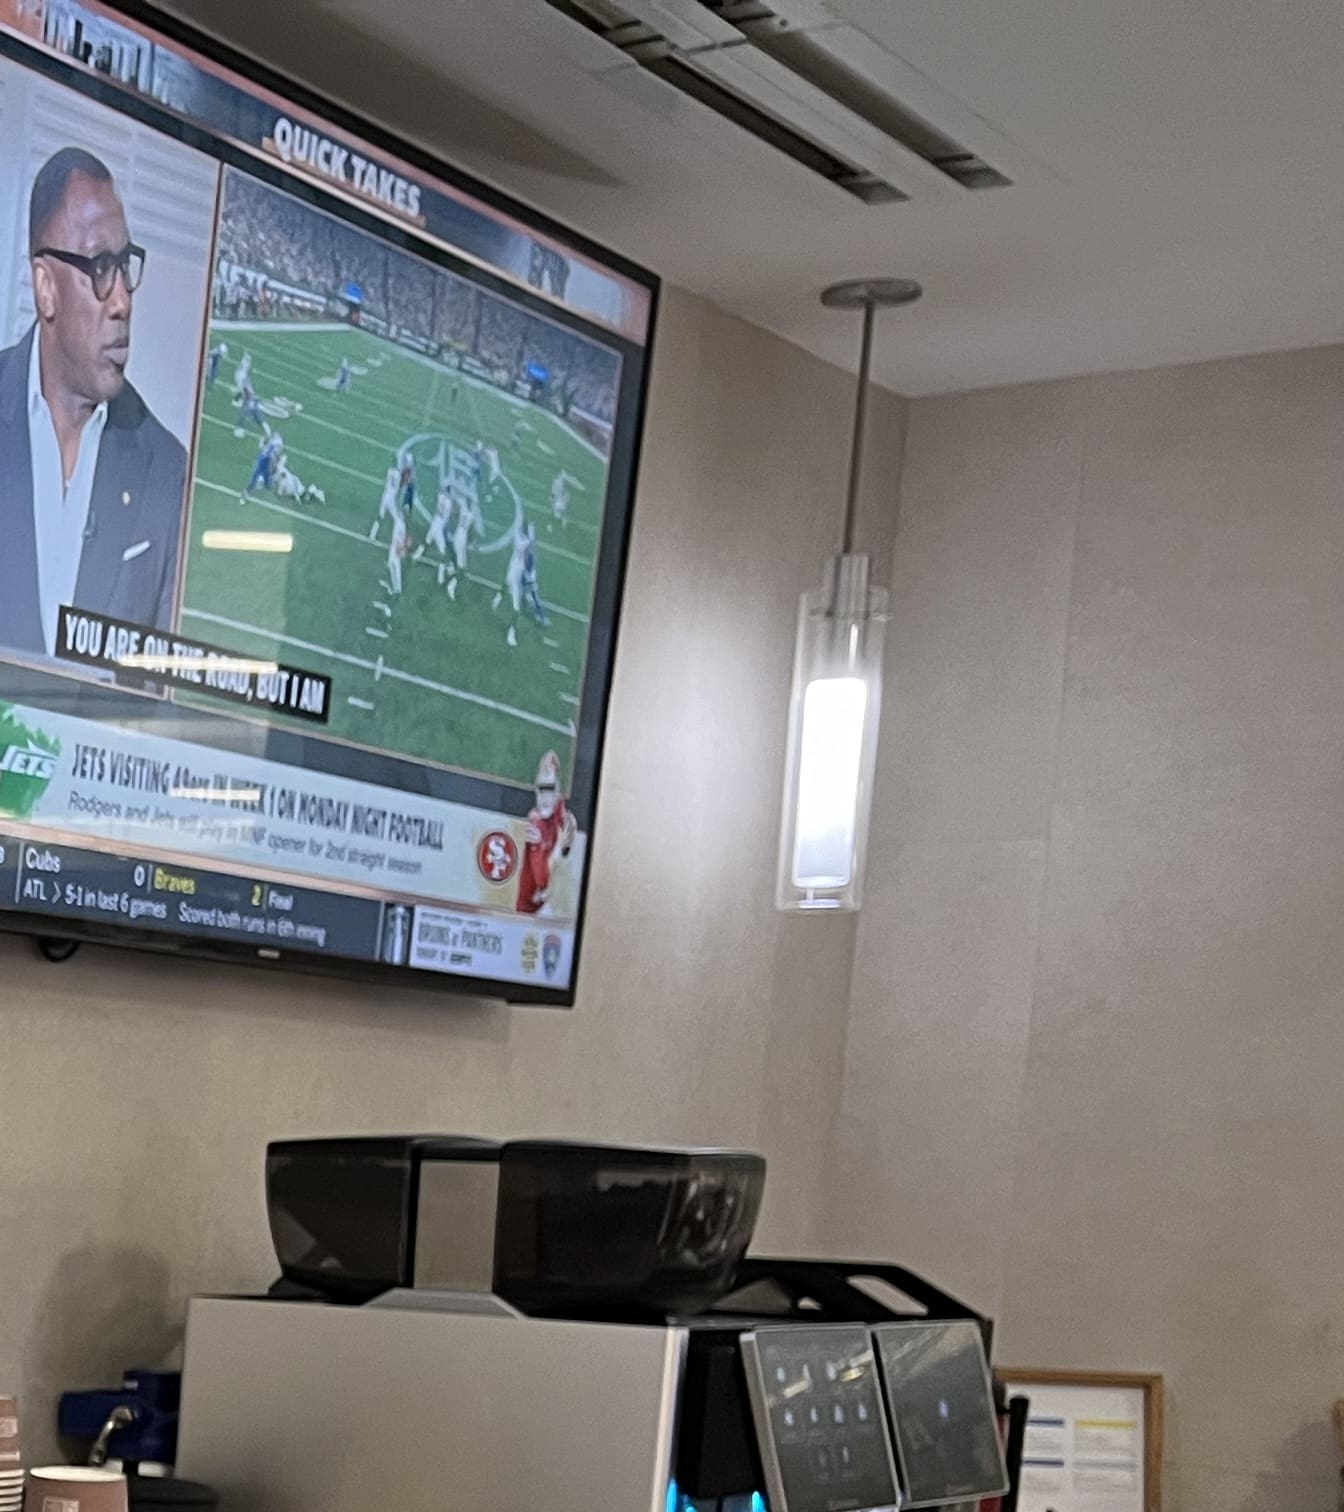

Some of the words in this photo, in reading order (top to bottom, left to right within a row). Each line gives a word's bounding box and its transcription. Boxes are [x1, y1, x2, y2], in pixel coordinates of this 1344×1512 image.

[274, 117, 347, 183] QUICK
[351, 156, 421, 217] TAKES
[65, 613, 103, 658] YOU
[104, 625, 141, 667] ARE
[143, 634, 169, 674] ON
[171, 641, 204, 684] THE
[205, 653, 253, 701] ROAD,
[256, 667, 290, 705] BUT
[288, 674, 299, 708] I
[299, 677, 326, 715] AM
[0, 740, 58, 780] JETS
[68, 790, 122, 819] Rodgers
[125, 806, 149, 823] and
[71, 743, 107, 783] JETS
[109, 752, 171, 796] VISITING
[213, 774, 229, 807] IN
[278, 786, 295, 822] ON
[297, 789, 349, 833] MONDAY
[349, 803, 387, 841] NIGHT
[389, 811, 445, 851] FOOTBALL
[25, 847, 62, 874] Cubs
[133, 864, 146, 887] 0
[153, 867, 197, 895] Braves
[23, 877, 48, 901] ATL
[84, 888, 96, 908] in
[97, 890, 119, 912] last
[119, 891, 129, 913] 6
[129, 897, 168, 919] games
[178, 900, 215, 926] Scored
